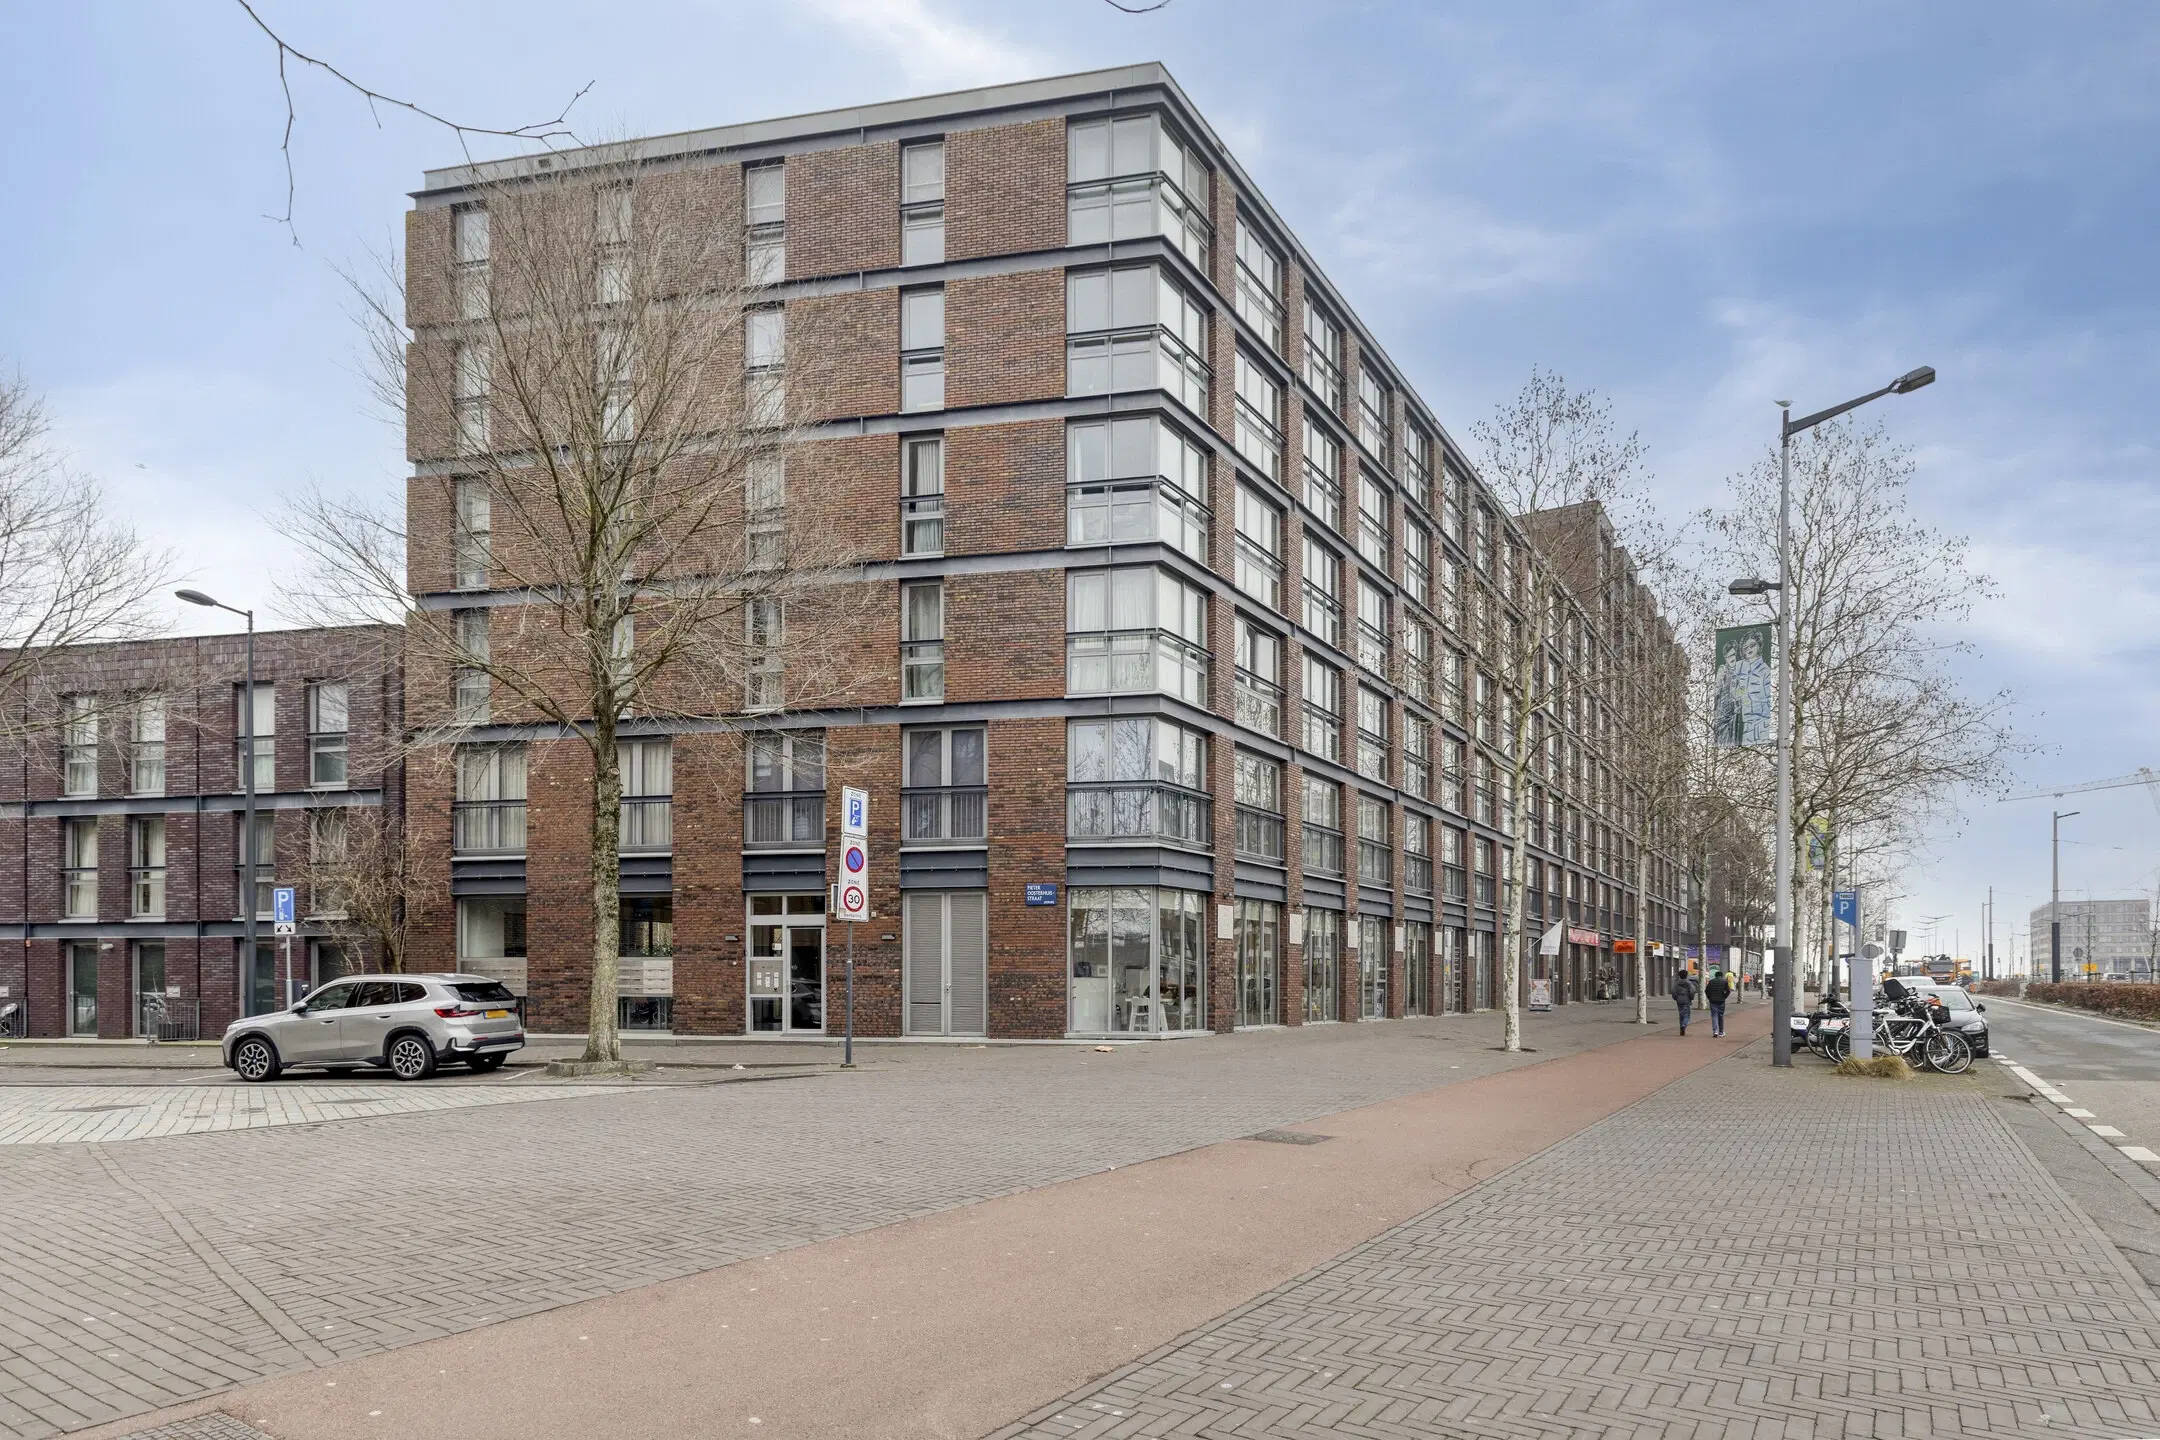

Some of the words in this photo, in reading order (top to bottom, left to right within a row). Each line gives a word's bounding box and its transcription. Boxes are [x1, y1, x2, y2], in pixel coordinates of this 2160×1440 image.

[852, 800, 859, 814] P
[278, 891, 288, 907] P
[848, 895, 860, 904] 30
[1840, 901, 1849, 914] P
